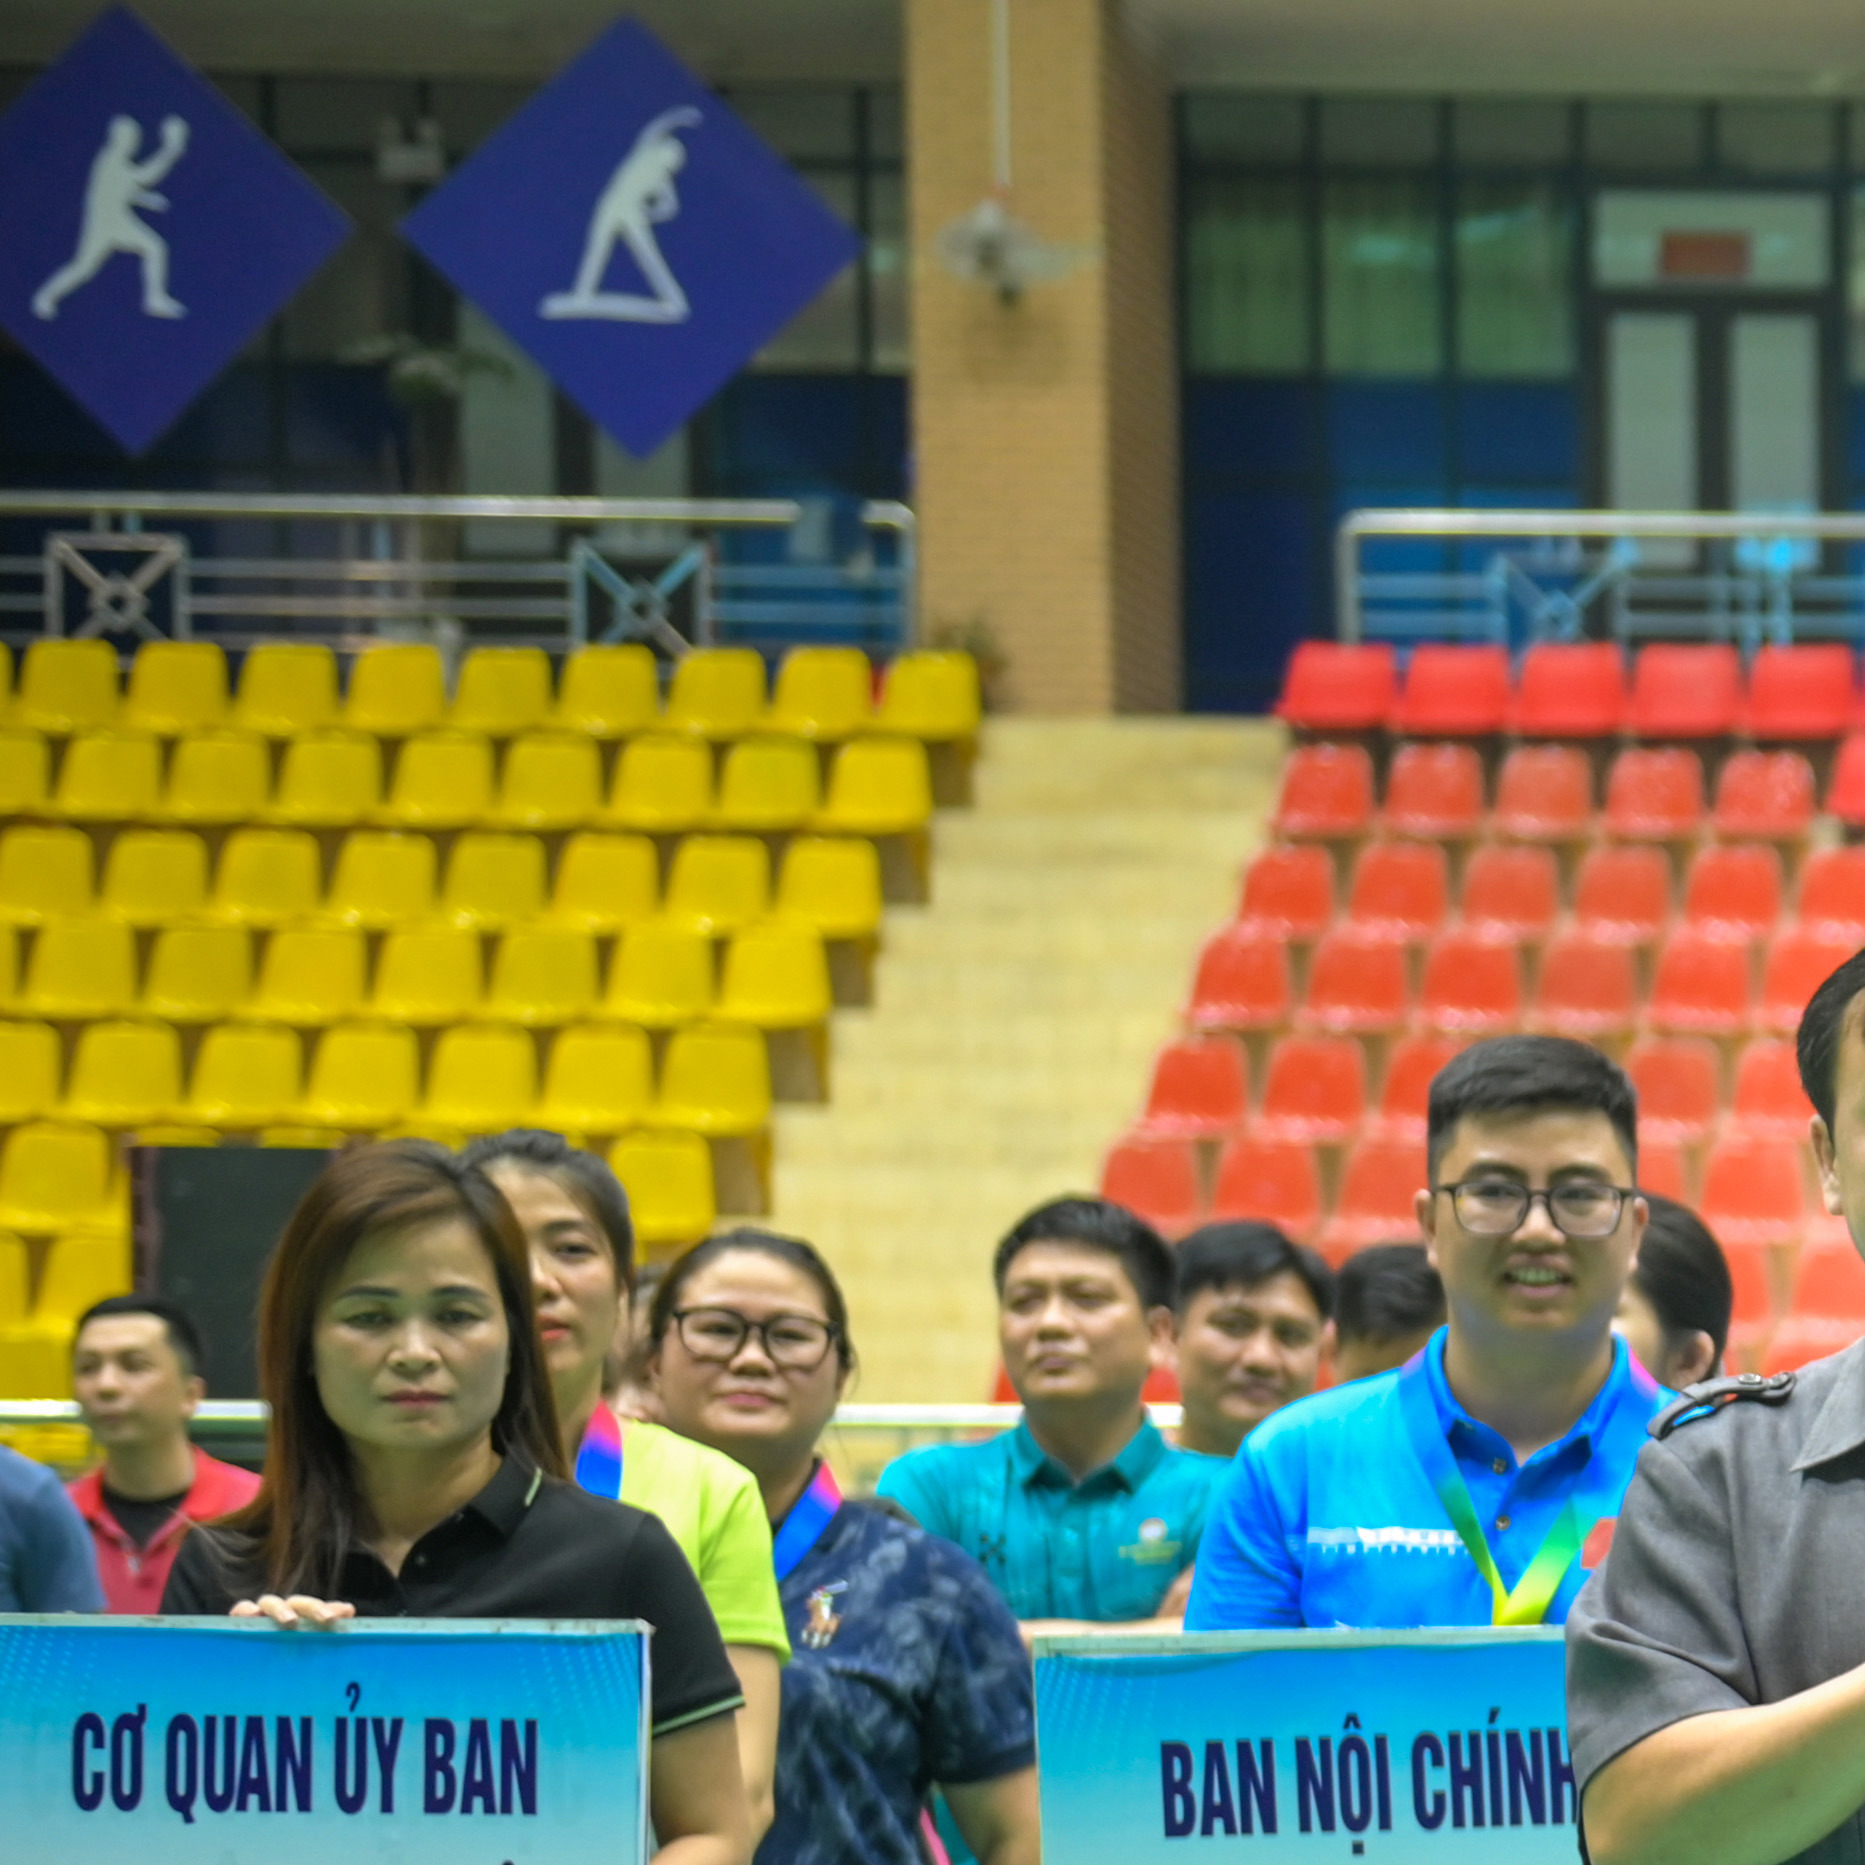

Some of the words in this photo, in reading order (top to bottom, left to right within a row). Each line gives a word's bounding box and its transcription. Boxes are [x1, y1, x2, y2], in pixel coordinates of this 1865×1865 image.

[72, 1703, 148, 1811] CƠ
[166, 1713, 312, 1823] QUAN
[335, 1682, 404, 1814] ỦY
[424, 1718, 538, 1816] BAN
[1160, 1738, 1277, 1837] BAN
[1295, 1713, 1393, 1855] NỘI
[1411, 1707, 1578, 1830] CHÍNH
